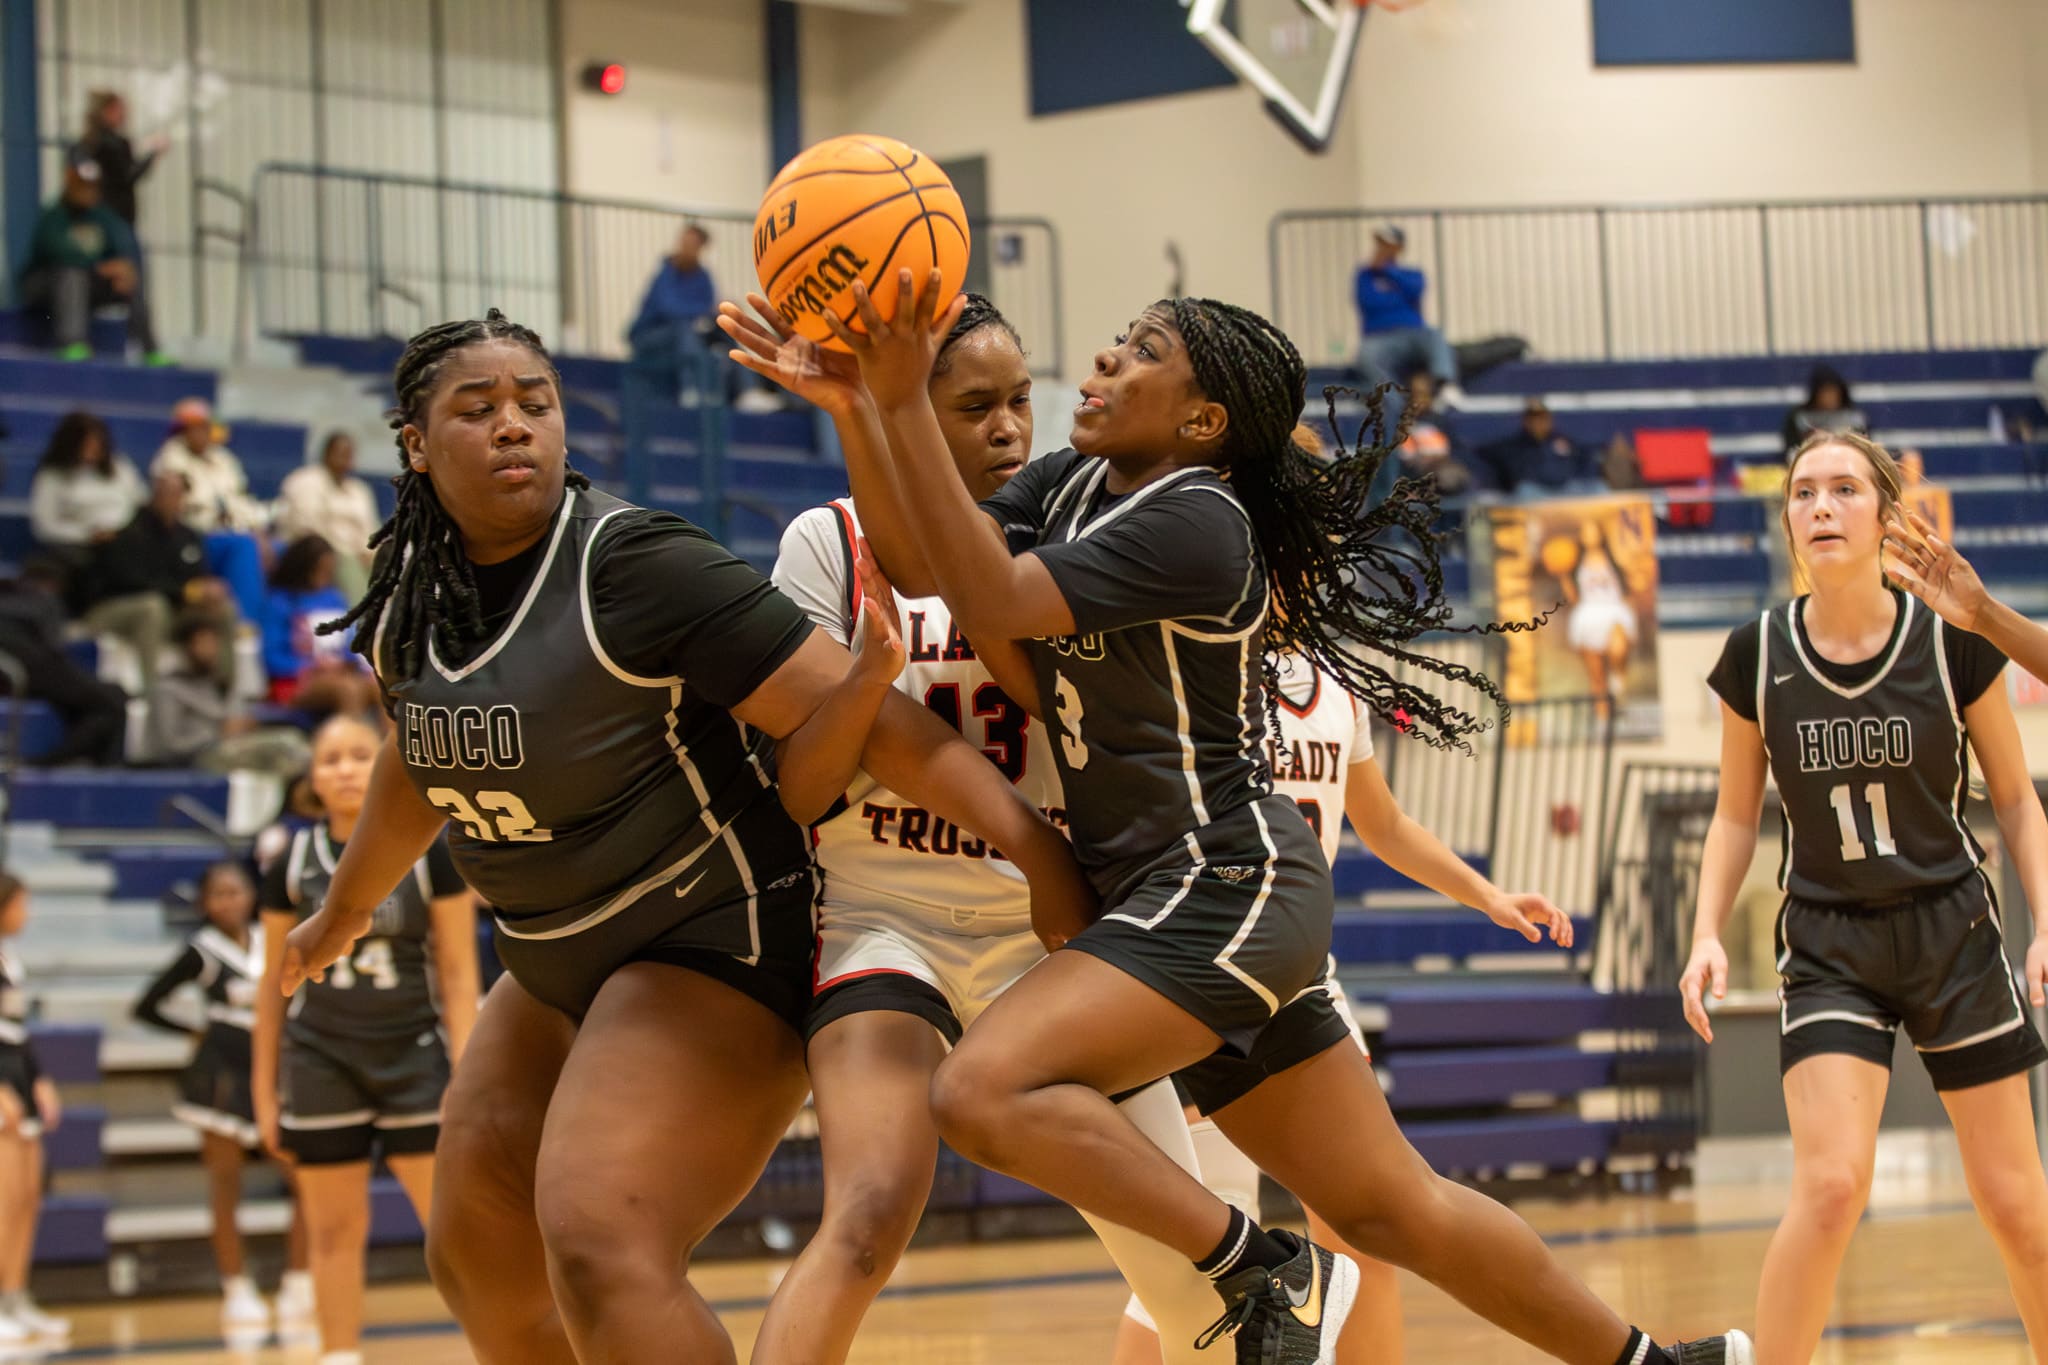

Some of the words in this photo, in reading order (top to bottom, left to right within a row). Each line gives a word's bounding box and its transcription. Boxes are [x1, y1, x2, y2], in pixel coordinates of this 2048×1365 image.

[777, 243, 869, 326] Wilso
[908, 611, 977, 663] LA
[405, 702, 526, 771] HOCO
[1055, 668, 1090, 771] 3
[1796, 716, 1914, 773] HOCO
[1265, 738, 1342, 784] LADY
[426, 786, 554, 843] 32
[1829, 782, 1898, 862] 11
[330, 937, 401, 990] 14
